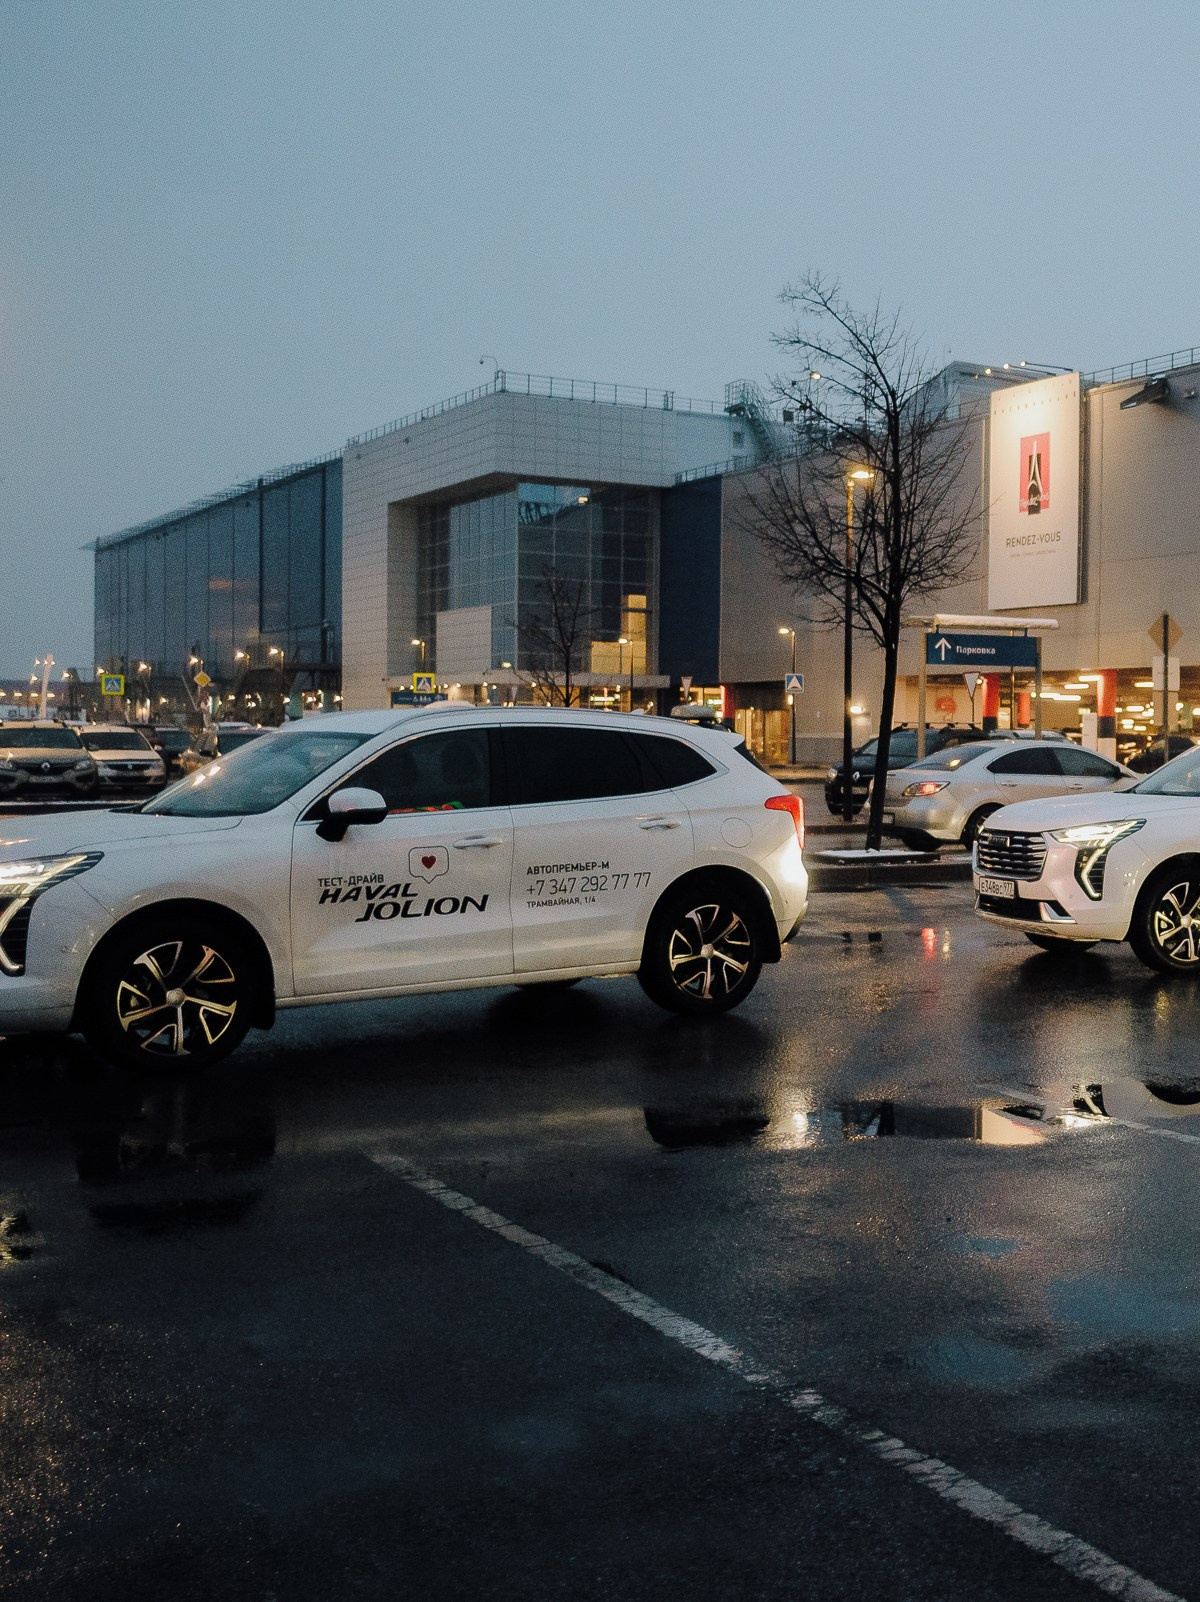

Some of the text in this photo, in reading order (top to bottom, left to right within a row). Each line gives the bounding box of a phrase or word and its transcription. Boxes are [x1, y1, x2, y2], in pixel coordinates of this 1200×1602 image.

[1006, 531, 1061, 548] RENDEZ-VOUS
[956, 645, 996, 656] Парковка
[526, 861, 610, 875] АВТОПРЕМЬЕР-М
[317, 873, 385, 888] ТЕСТ-ДРАЙВ
[526, 871, 651, 896] +7 347 292 77 77
[318, 883, 419, 905] HAVAL
[354, 894, 489, 922] JOLION
[526, 897, 582, 909] ТРАМВАЙНАЯ,
